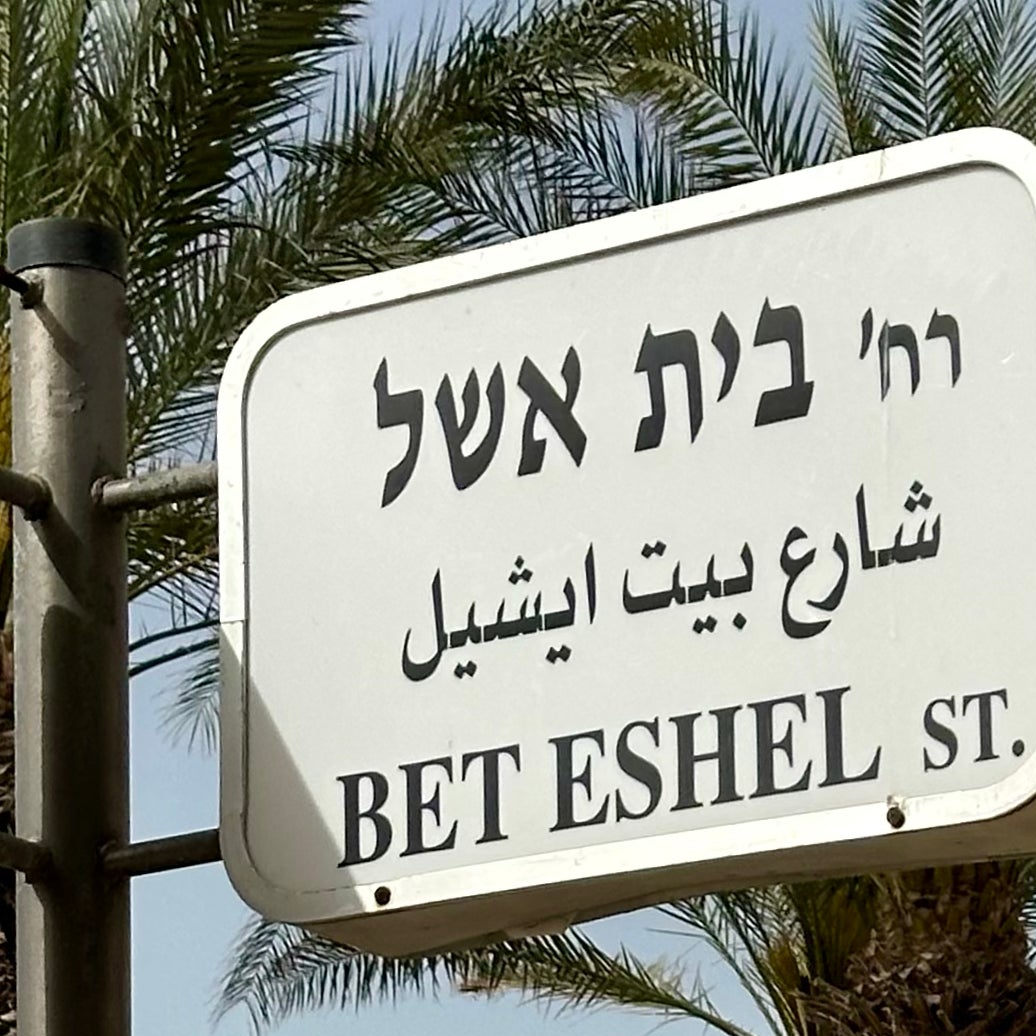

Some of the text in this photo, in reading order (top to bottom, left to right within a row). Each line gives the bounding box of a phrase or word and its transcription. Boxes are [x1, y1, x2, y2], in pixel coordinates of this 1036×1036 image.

[373, 297, 961, 508] רח' בית אשל
[401, 480, 941, 682] شارع بيت ايشيل
[335, 686, 1025, 870] BET ESHEL ST.
